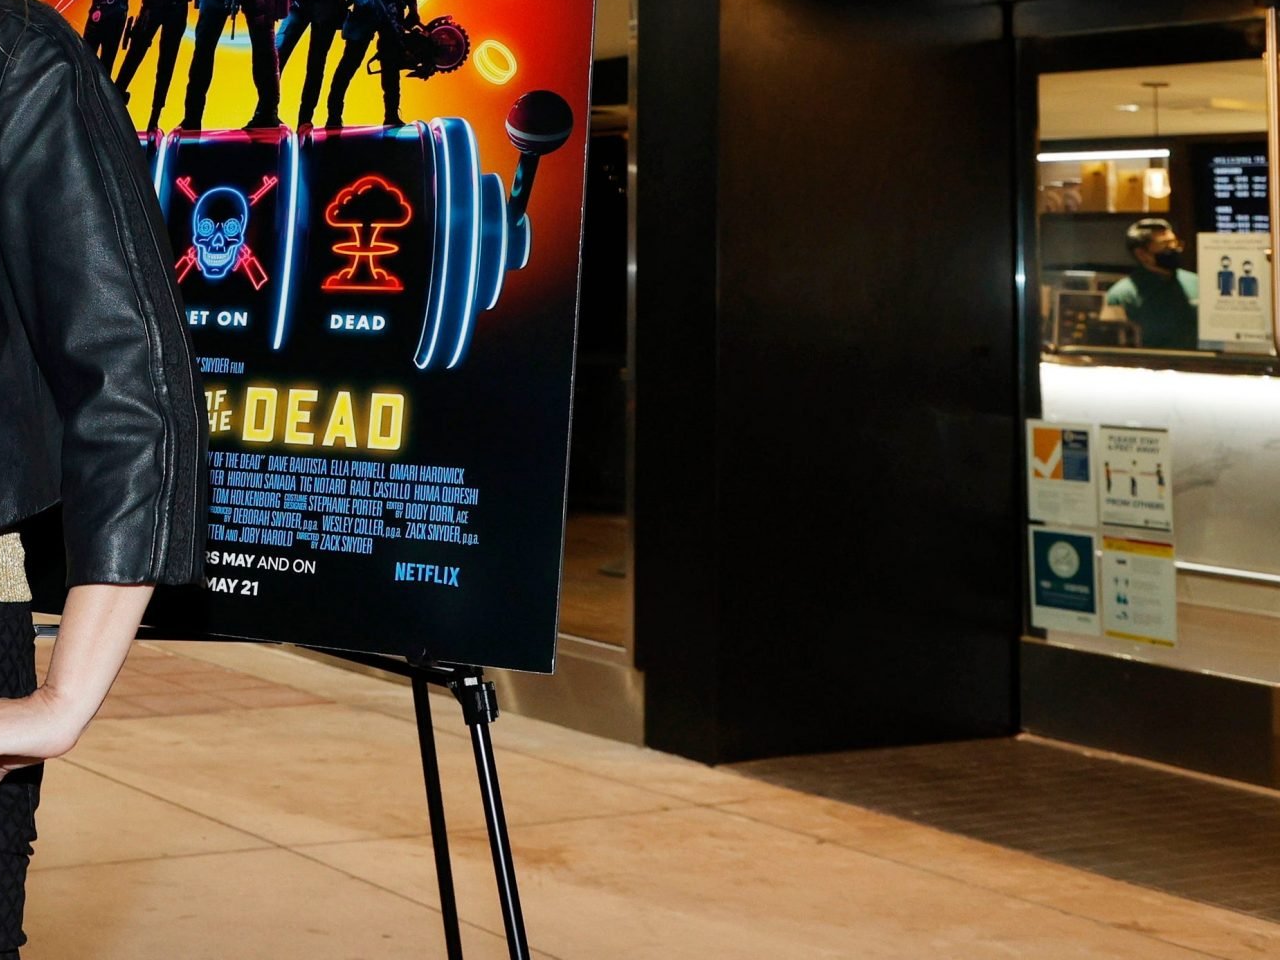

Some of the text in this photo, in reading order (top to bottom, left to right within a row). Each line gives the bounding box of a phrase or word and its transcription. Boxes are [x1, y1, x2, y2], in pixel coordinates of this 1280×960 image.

[186, 311, 386, 331] ET ON DEAD
[200, 357, 230, 374] SNYDER
[230, 360, 244, 374] FILM
[242, 386, 405, 450] DEAD
[214, 452, 224, 468] OF
[225, 452, 239, 468] THE
[268, 455, 288, 472] DAVE
[289, 456, 327, 475] BAUTISTA
[330, 460, 349, 476] ELLA
[351, 460, 385, 479] PURNELL
[390, 464, 418, 481] OMARI
[420, 466, 464, 484] HARDWICK
[227, 470, 264, 488] HIROYUKI
[264, 473, 296, 491] SANADA
[300, 476, 312, 492] TIG
[314, 476, 346, 495] NOTARO
[350, 478, 370, 497] RAÚL
[373, 482, 410, 500] CASTILLO
[414, 484, 440, 502] HUMA
[442, 486, 478, 505] QURESHI
[212, 488, 281, 508] TOM HOLKENBORG
[308, 496, 382, 516] STEPHANIE PORTER
[386, 502, 404, 510] EDITED
[224, 514, 230, 522] BY
[395, 510, 403, 518] BY
[405, 503, 469, 524] DODY DORN, ACE
[233, 508, 270, 526] DEBORAH
[271, 510, 302, 529] SNYDER,
[322, 516, 354, 533] WESLEY
[354, 518, 384, 537] COLLER,
[405, 522, 426, 540] ZACK
[428, 524, 461, 544] SNYDER,
[296, 532, 320, 540] DIRECTED
[225, 529, 238, 542] AND
[239, 527, 260, 544] JOBY
[261, 529, 294, 547] HAROLD
[311, 542, 318, 550] BY
[320, 534, 372, 554] ZACK SNYDER
[222, 552, 255, 568] MAY
[257, 556, 290, 572] AND
[292, 559, 316, 575] ON
[395, 562, 460, 588] NETFLIX
[206, 577, 258, 596] MAY 21
